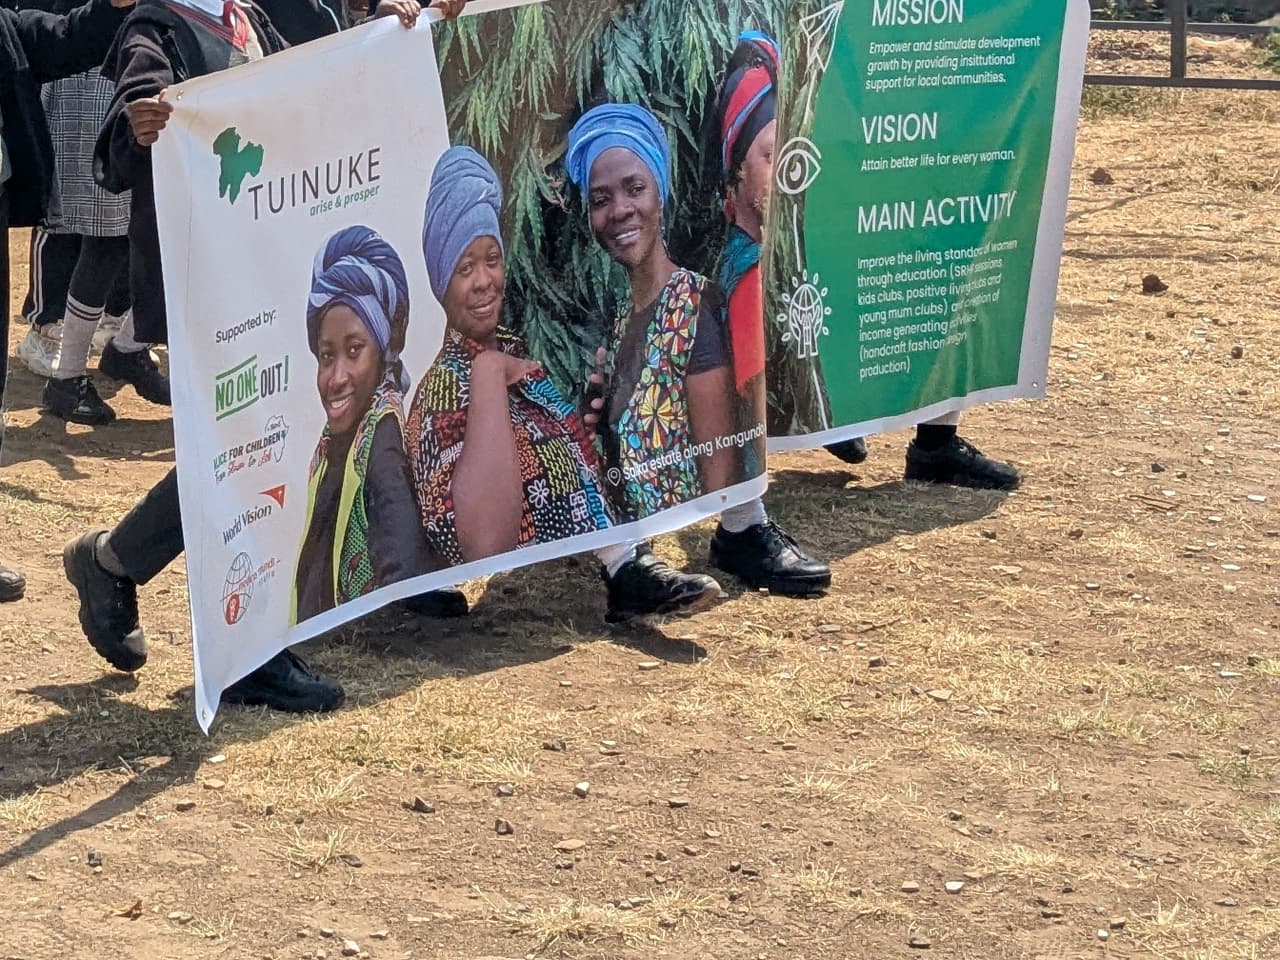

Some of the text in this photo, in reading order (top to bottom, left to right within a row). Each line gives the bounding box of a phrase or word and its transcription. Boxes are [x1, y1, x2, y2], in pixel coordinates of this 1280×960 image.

[869, 35, 1041, 56] Empower and stimulate development
[867, 57, 899, 75] growth
[901, 56, 912, 72] by
[915, 55, 958, 72] providing
[865, 71, 1006, 92] support for local communities.
[861, 112, 938, 145] VISION
[860, 150, 1016, 171] Attain better life for every woman.
[248, 147, 380, 220] TUINUKE
[310, 185, 380, 217] arise & prosper
[857, 190, 1018, 234] MAIN ACTIVITY
[857, 256, 895, 272] Improve
[897, 251, 913, 265] the
[915, 249, 942, 266] living
[857, 272, 893, 289] through
[894, 267, 947, 283] education
[857, 291, 876, 306] kids
[877, 288, 904, 303] clubs,
[906, 283, 947, 303] positive
[215, 309, 277, 344] Supported by:
[859, 311, 887, 328] young
[888, 307, 913, 320] mum
[914, 299, 948, 316] clubs)
[859, 327, 892, 342] income
[893, 319, 948, 340] generating
[859, 343, 907, 362] (handcraft
[908, 337, 945, 353] fashion
[859, 357, 911, 382] production)
[215, 355, 289, 413] NO ONE OUT!
[228, 445, 244, 461] FOR
[245, 431, 281, 454] CHILDREN
[650, 451, 682, 471] estate
[684, 440, 713, 460] along
[222, 504, 272, 545] World Vision
